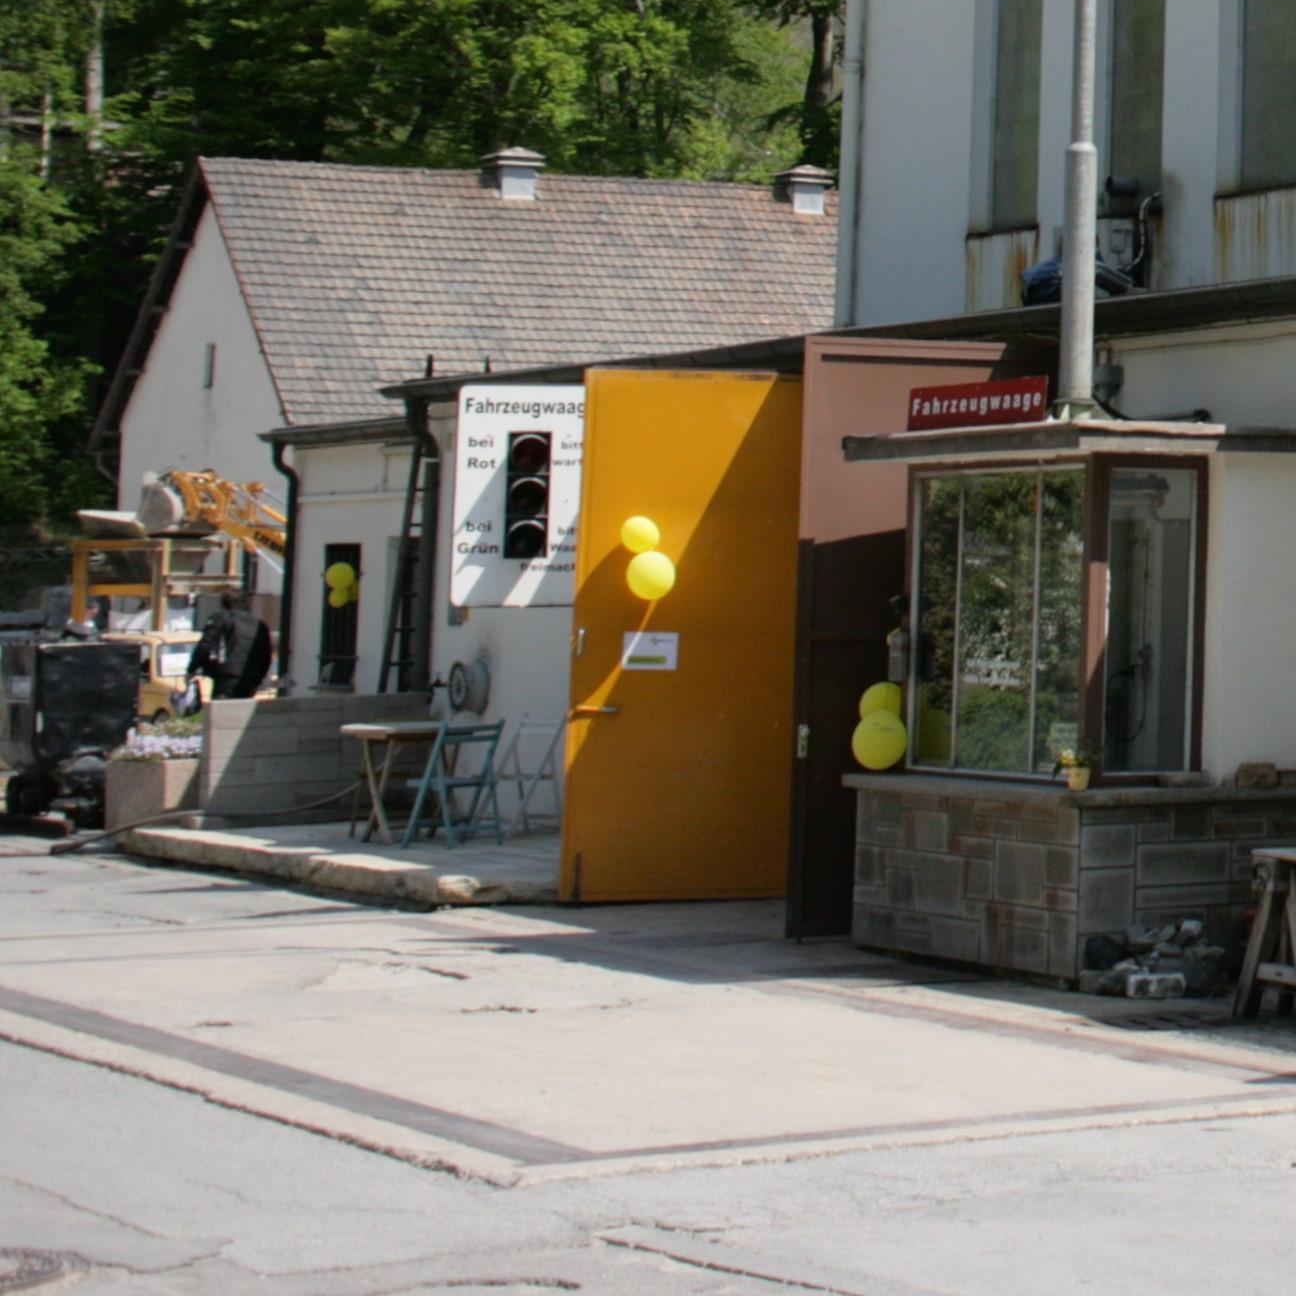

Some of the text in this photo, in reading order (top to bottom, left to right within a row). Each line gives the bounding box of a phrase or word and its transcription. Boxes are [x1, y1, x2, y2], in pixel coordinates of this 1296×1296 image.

[464, 397, 585, 418] Fahrzeugwaag
[911, 390, 1042, 416] Fahrzeugwaage
[468, 435, 494, 448] bei
[466, 457, 497, 469] Rot
[456, 541, 499, 554] Grün
